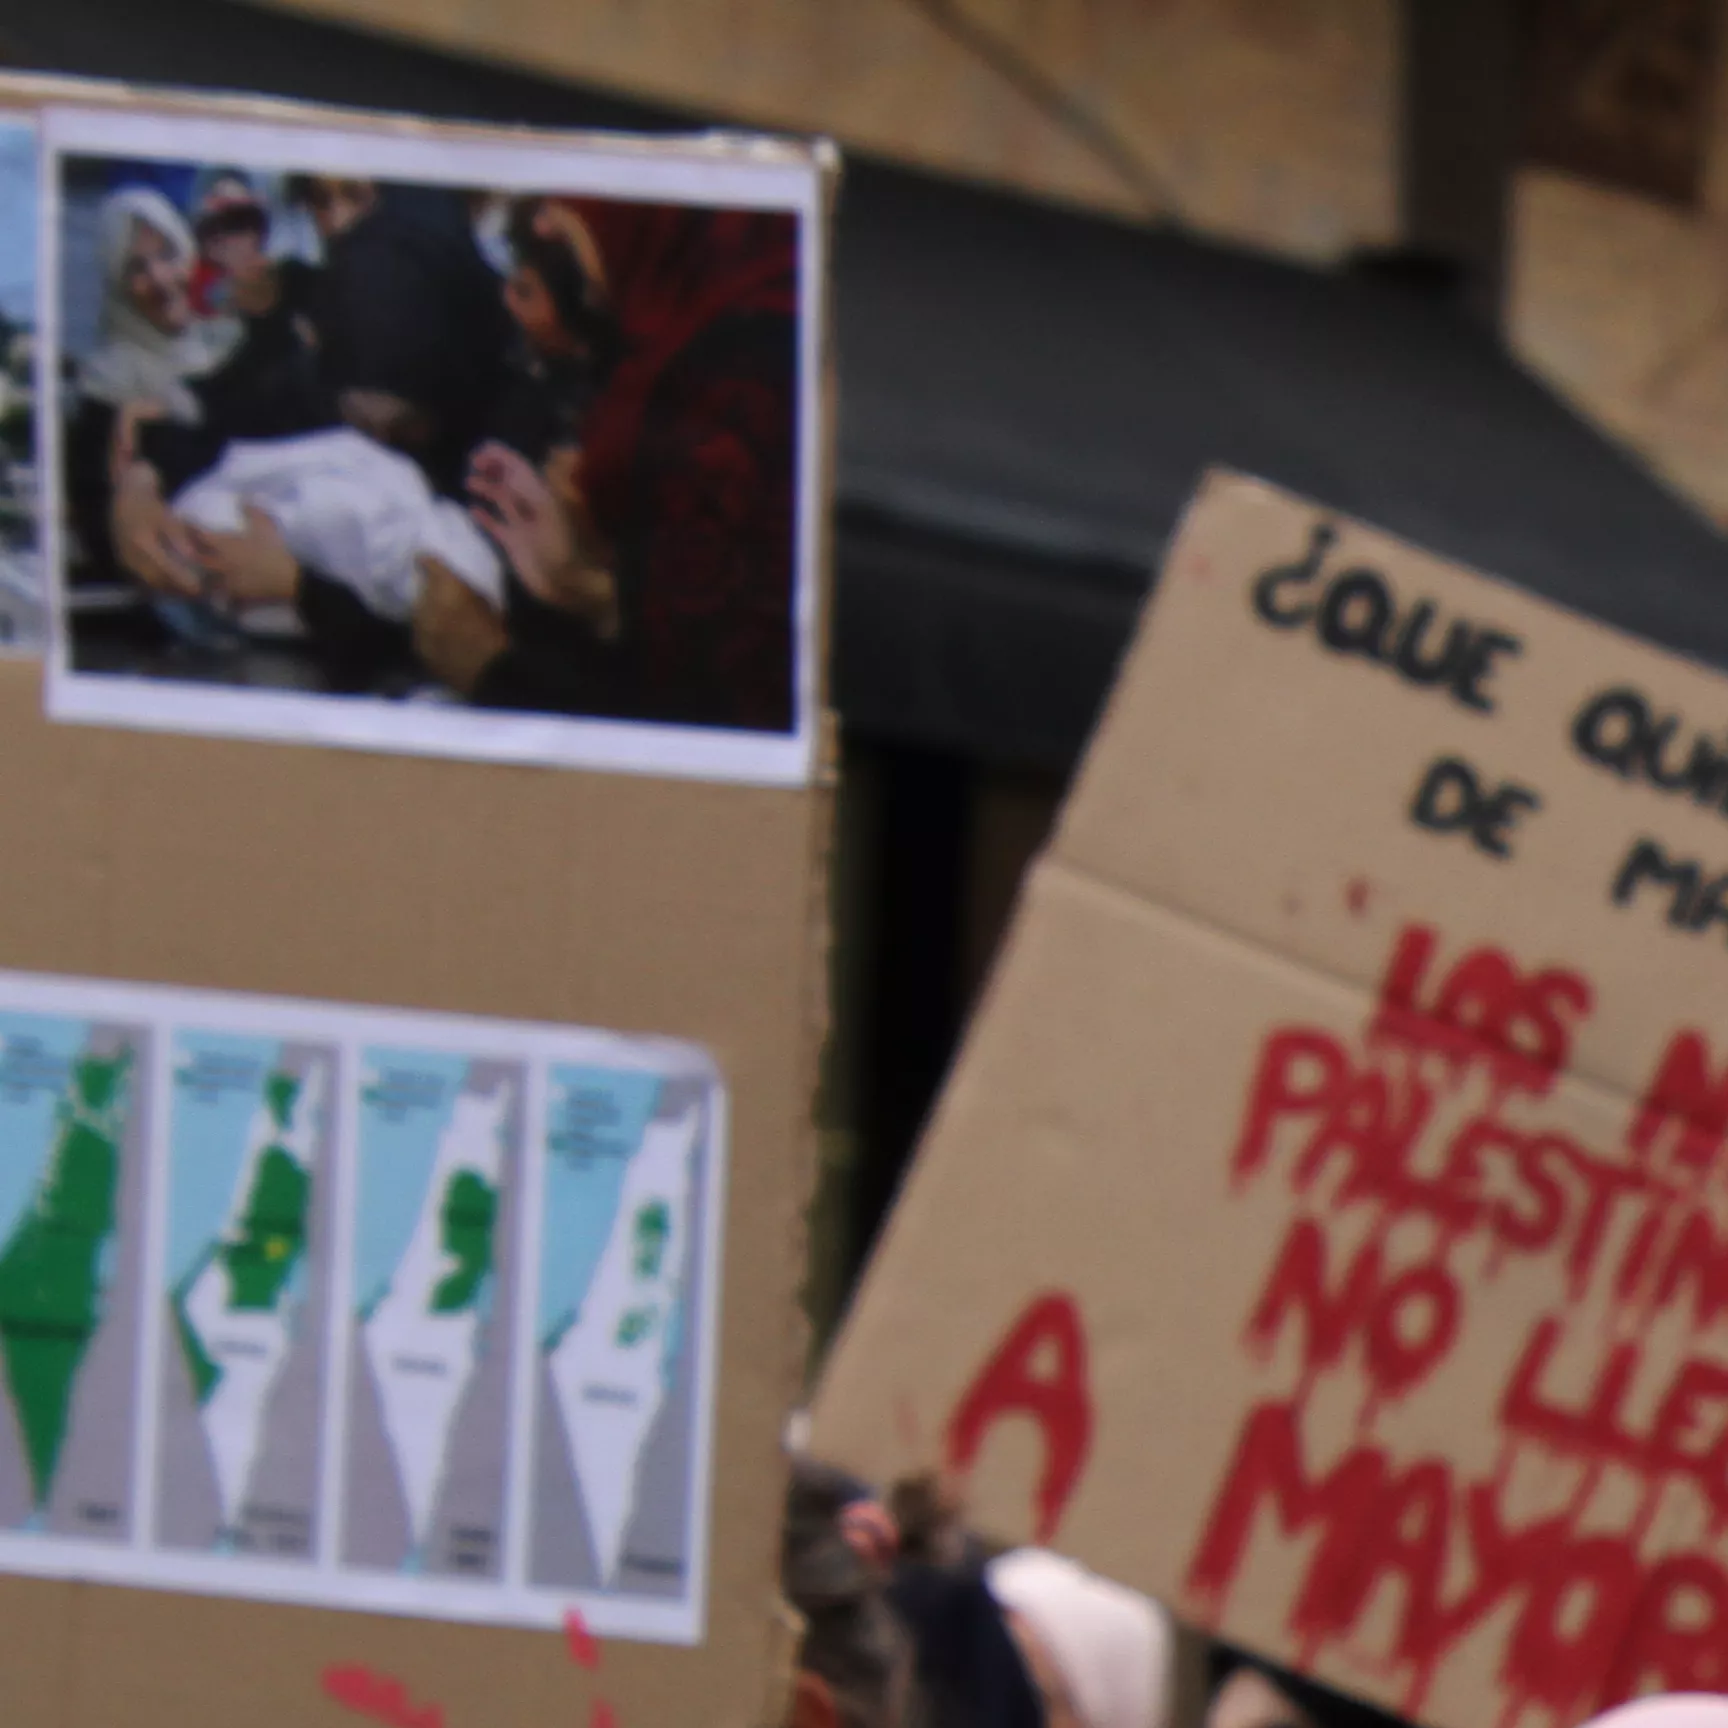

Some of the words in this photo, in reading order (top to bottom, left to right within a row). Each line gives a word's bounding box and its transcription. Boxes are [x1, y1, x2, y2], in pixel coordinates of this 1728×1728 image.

[1253, 522, 1525, 713] ¿QUE
[1410, 755, 1546, 858] DE
[1370, 922, 1594, 1095] LOS
[1240, 1212, 1464, 1400] NO
[946, 1286, 1093, 1548] A
